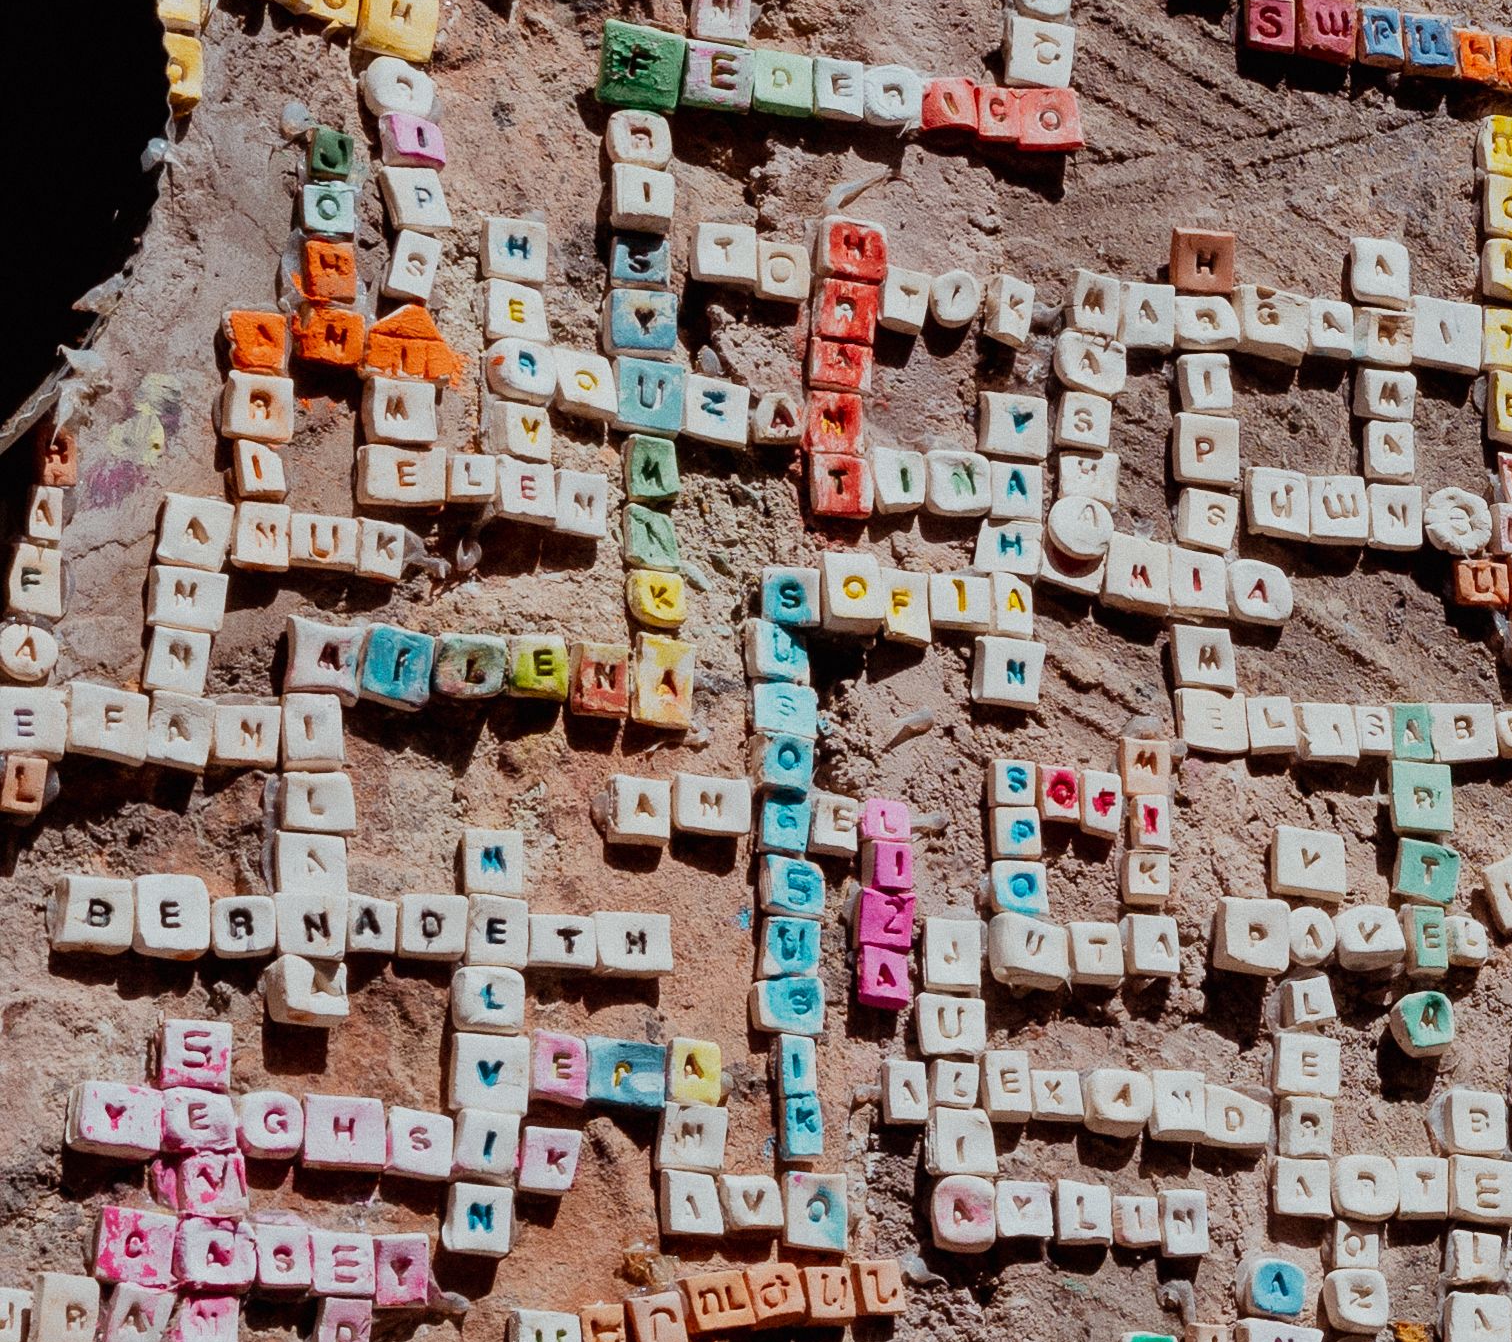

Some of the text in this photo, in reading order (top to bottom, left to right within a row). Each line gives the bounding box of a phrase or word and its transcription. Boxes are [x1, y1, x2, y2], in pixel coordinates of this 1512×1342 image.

[619, 45, 1066, 139] FEDERICO
[768, 567, 1037, 624] SOFIA
[1119, 556, 1279, 611] MIA
[78, 892, 655, 963] BERNADETTH
[864, 802, 919, 1000] LIZA
[1236, 909, 1491, 960] PAVEL
[460, 837, 519, 1238] MELVIN
[94, 1095, 578, 1184] YEGHSIK
